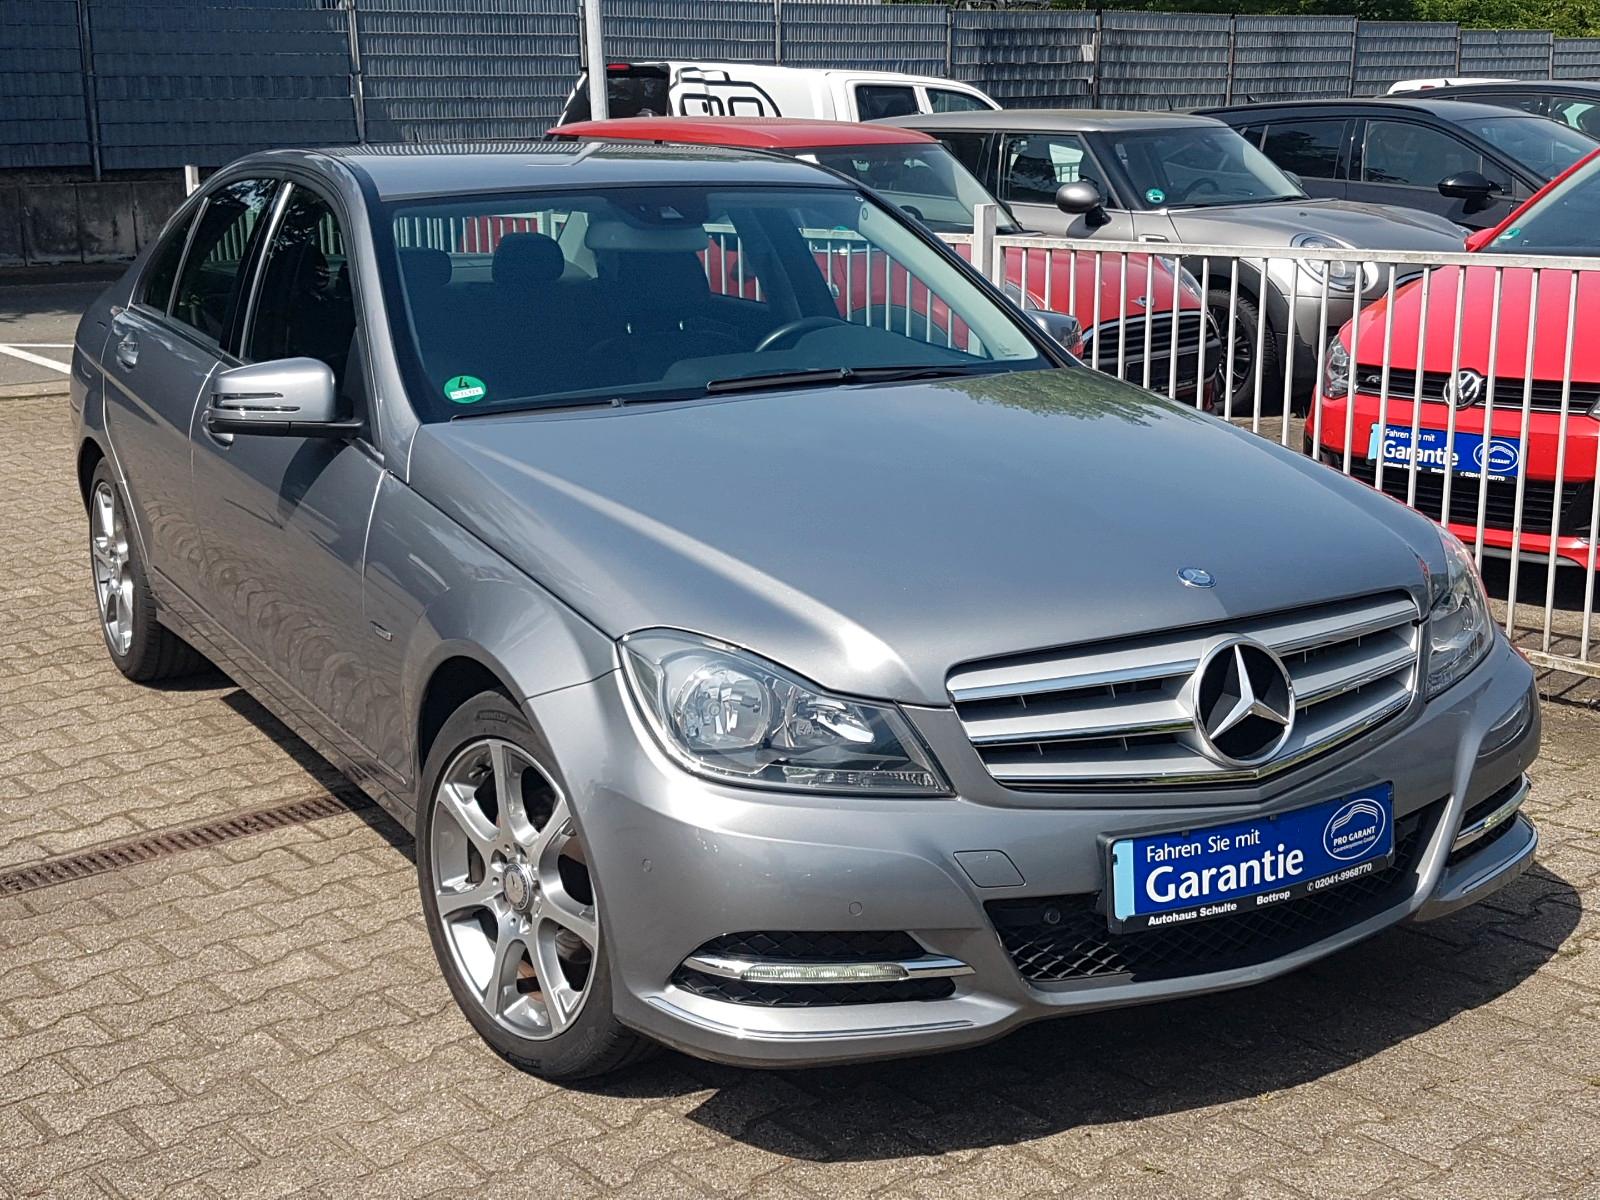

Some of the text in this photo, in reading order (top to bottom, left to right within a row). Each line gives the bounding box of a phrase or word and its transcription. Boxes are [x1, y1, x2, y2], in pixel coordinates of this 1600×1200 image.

[458, 377, 470, 389] 4
[1385, 429, 1409, 439] Fahren
[1423, 433, 1435, 442] mit
[1146, 829, 1261, 862] Fahren Sie mit
[1333, 826, 1376, 847] PRO GARANT
[1145, 843, 1304, 903] Garantie
[1147, 863, 1373, 926] Autohaus Schulte Bottrop 02041-9968770
